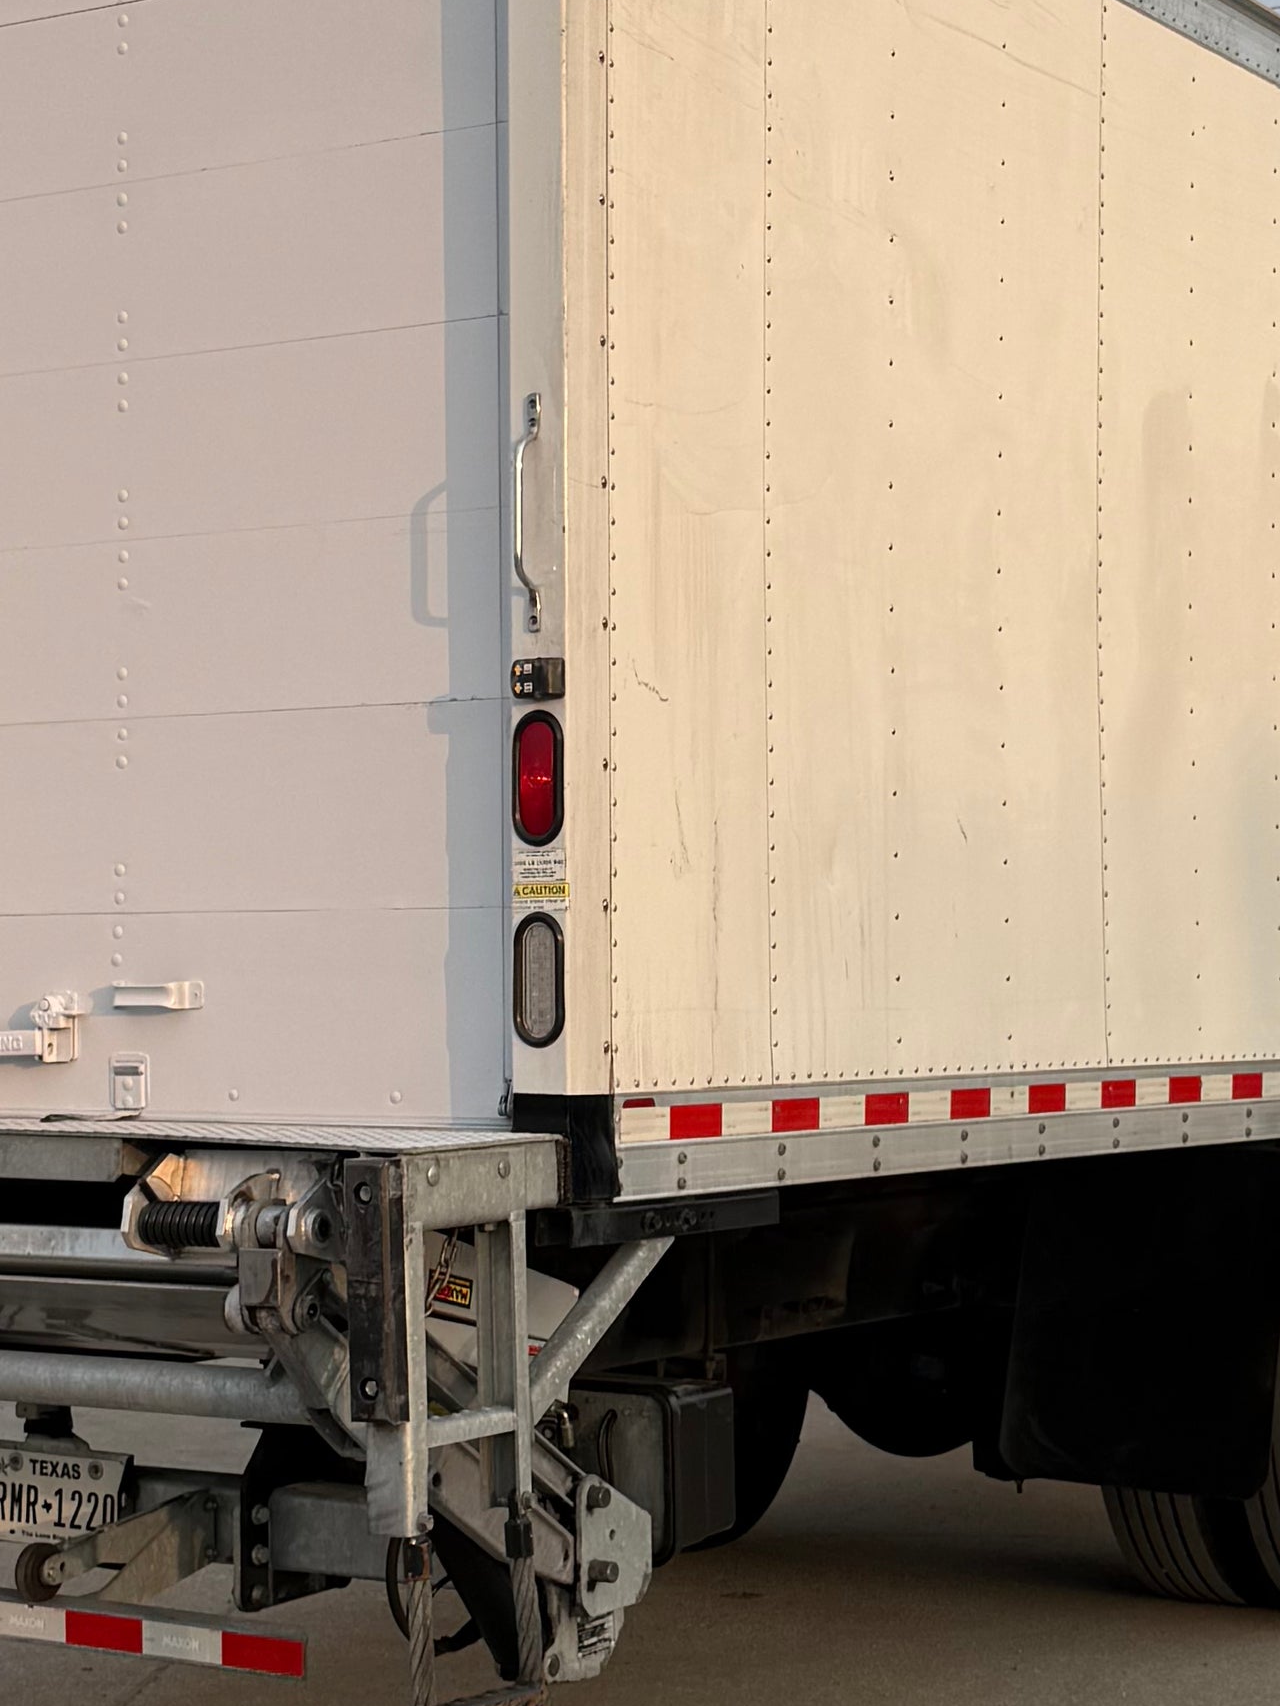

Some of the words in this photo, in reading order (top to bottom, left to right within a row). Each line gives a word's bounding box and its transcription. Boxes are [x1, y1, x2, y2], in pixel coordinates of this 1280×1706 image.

[522, 885, 566, 896] CAUTION
[29, 1458, 81, 1480] TEXAS
[53, 1488, 116, 1532] 1220
[9, 1615, 45, 1630] MAXON
[163, 1634, 200, 1651] MAXON
